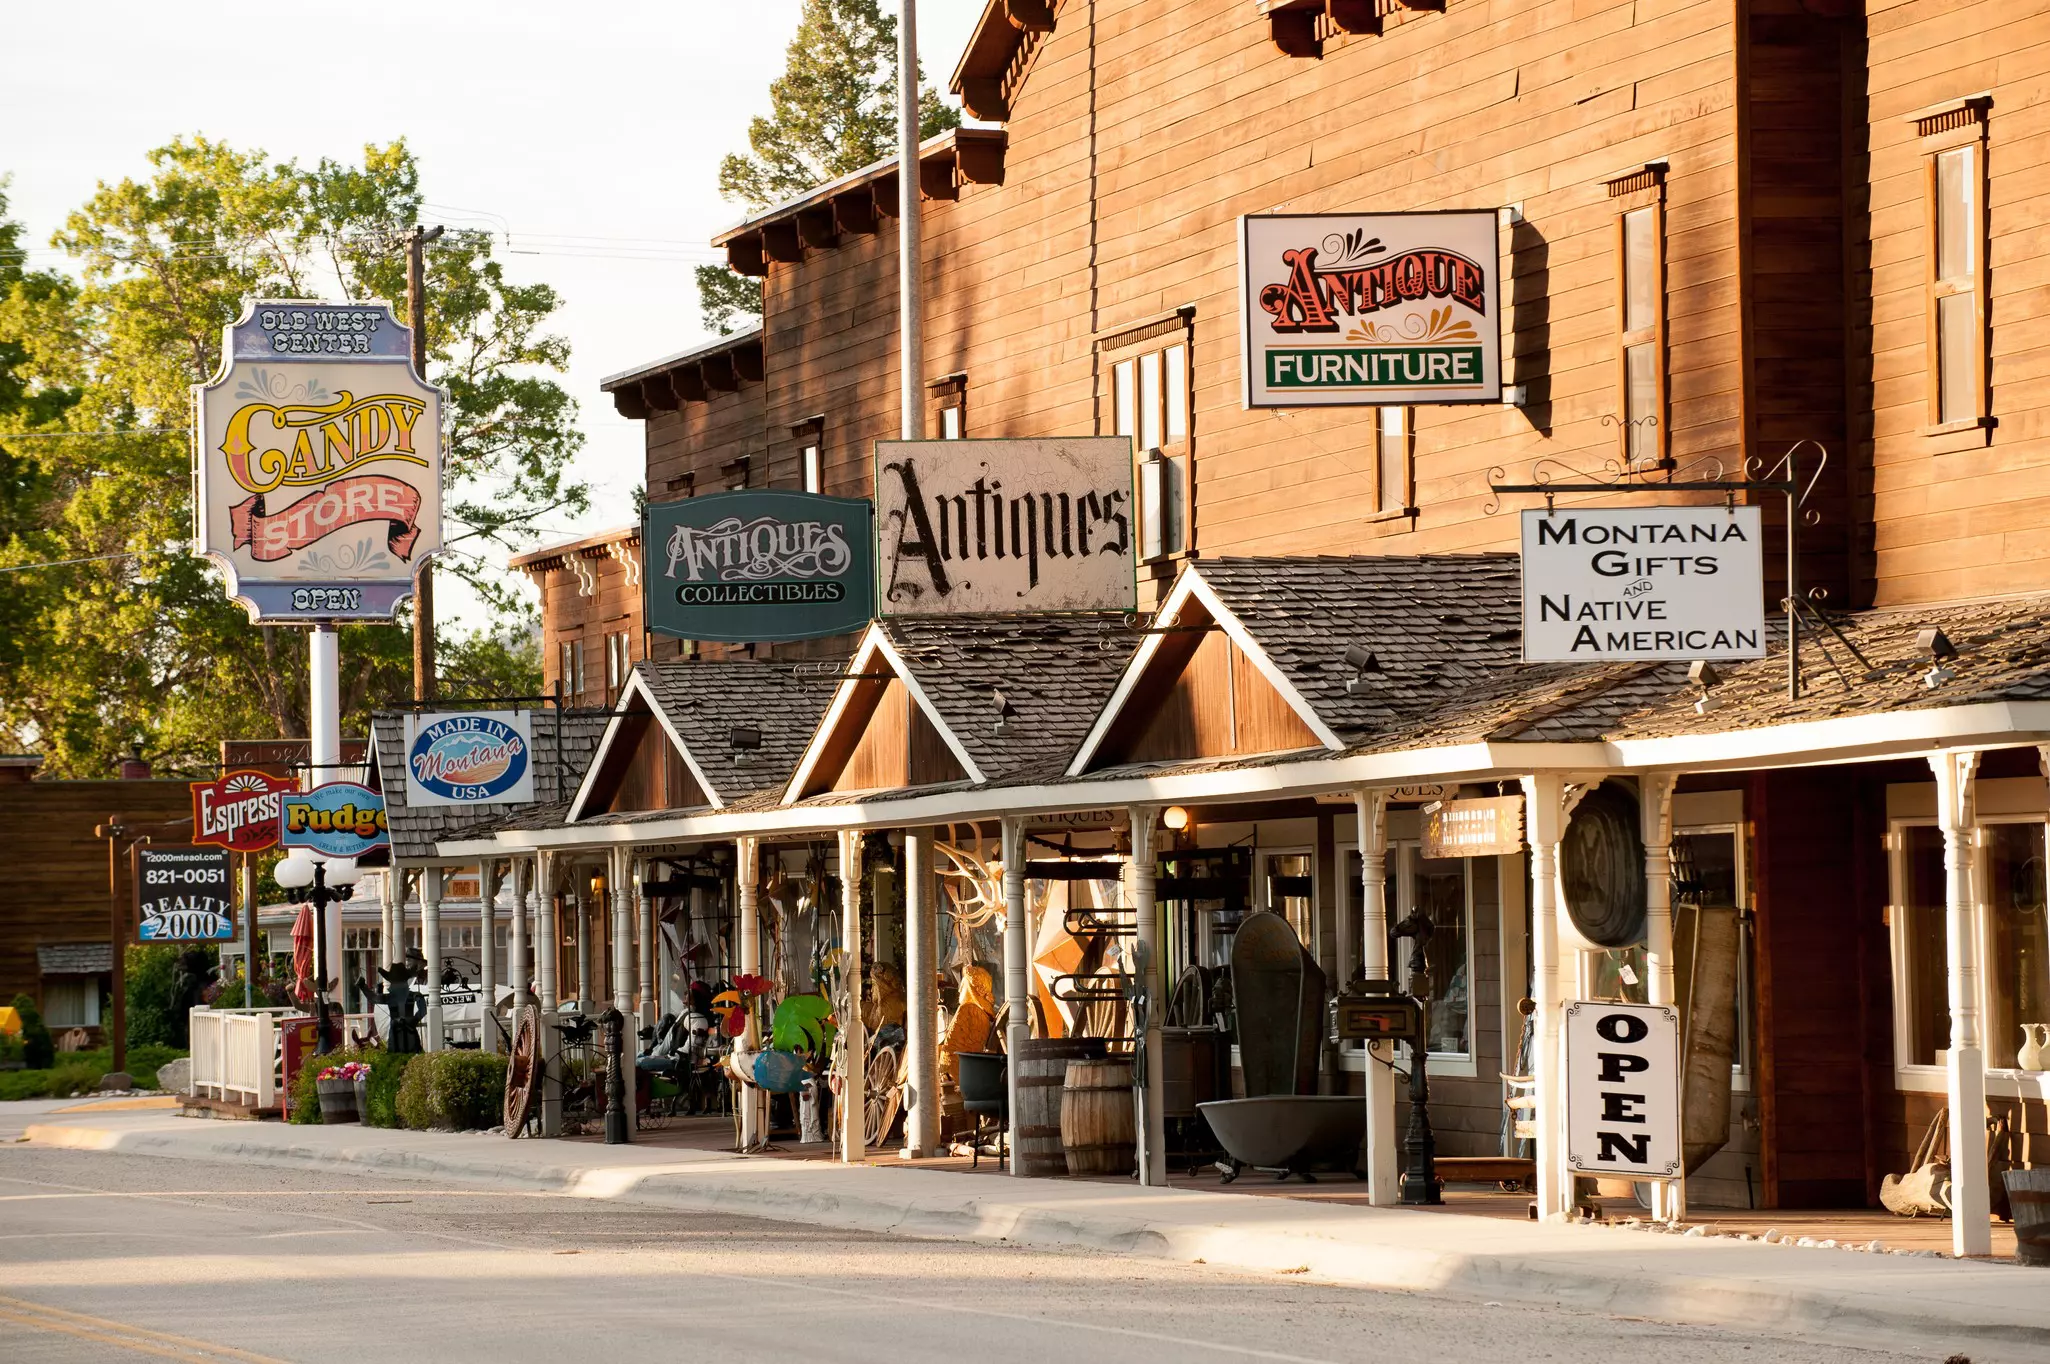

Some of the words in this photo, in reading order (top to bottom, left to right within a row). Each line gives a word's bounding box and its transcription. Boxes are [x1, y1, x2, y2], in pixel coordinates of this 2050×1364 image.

[1260, 247, 1486, 333] ANTIQUE
[260, 310, 308, 331] OLD
[313, 311, 382, 332] WEST
[272, 333, 371, 353] CENTER
[1274, 351, 1475, 383] FURNITURE
[218, 391, 428, 493] CANDY
[263, 483, 405, 550] STORE
[883, 458, 1130, 603] Antiques
[1538, 518, 1748, 545] MONTANA
[664, 518, 851, 580] ANTIQUES
[1591, 550, 1719, 577] GIFTS
[292, 588, 360, 612] OPEN
[681, 583, 841, 604] COLLECTIBLES
[1623, 580, 1653, 597] AND
[1540, 594, 1667, 622] NATIVE
[1570, 624, 1758, 652] AMERICAN
[426, 718, 481, 742] MADE
[486, 720, 509, 739] IN
[413, 736, 523, 782] Montana
[313, 792, 324, 801] We
[325, 787, 343, 796] make
[357, 792, 370, 801] own
[451, 786, 490, 799] USA
[201, 788, 290, 842] Espress
[146, 868, 225, 884] 821-0051
[141, 895, 231, 920] REALTY
[152, 913, 219, 939] 2000
[1596, 1013, 1651, 1164] OPEN
